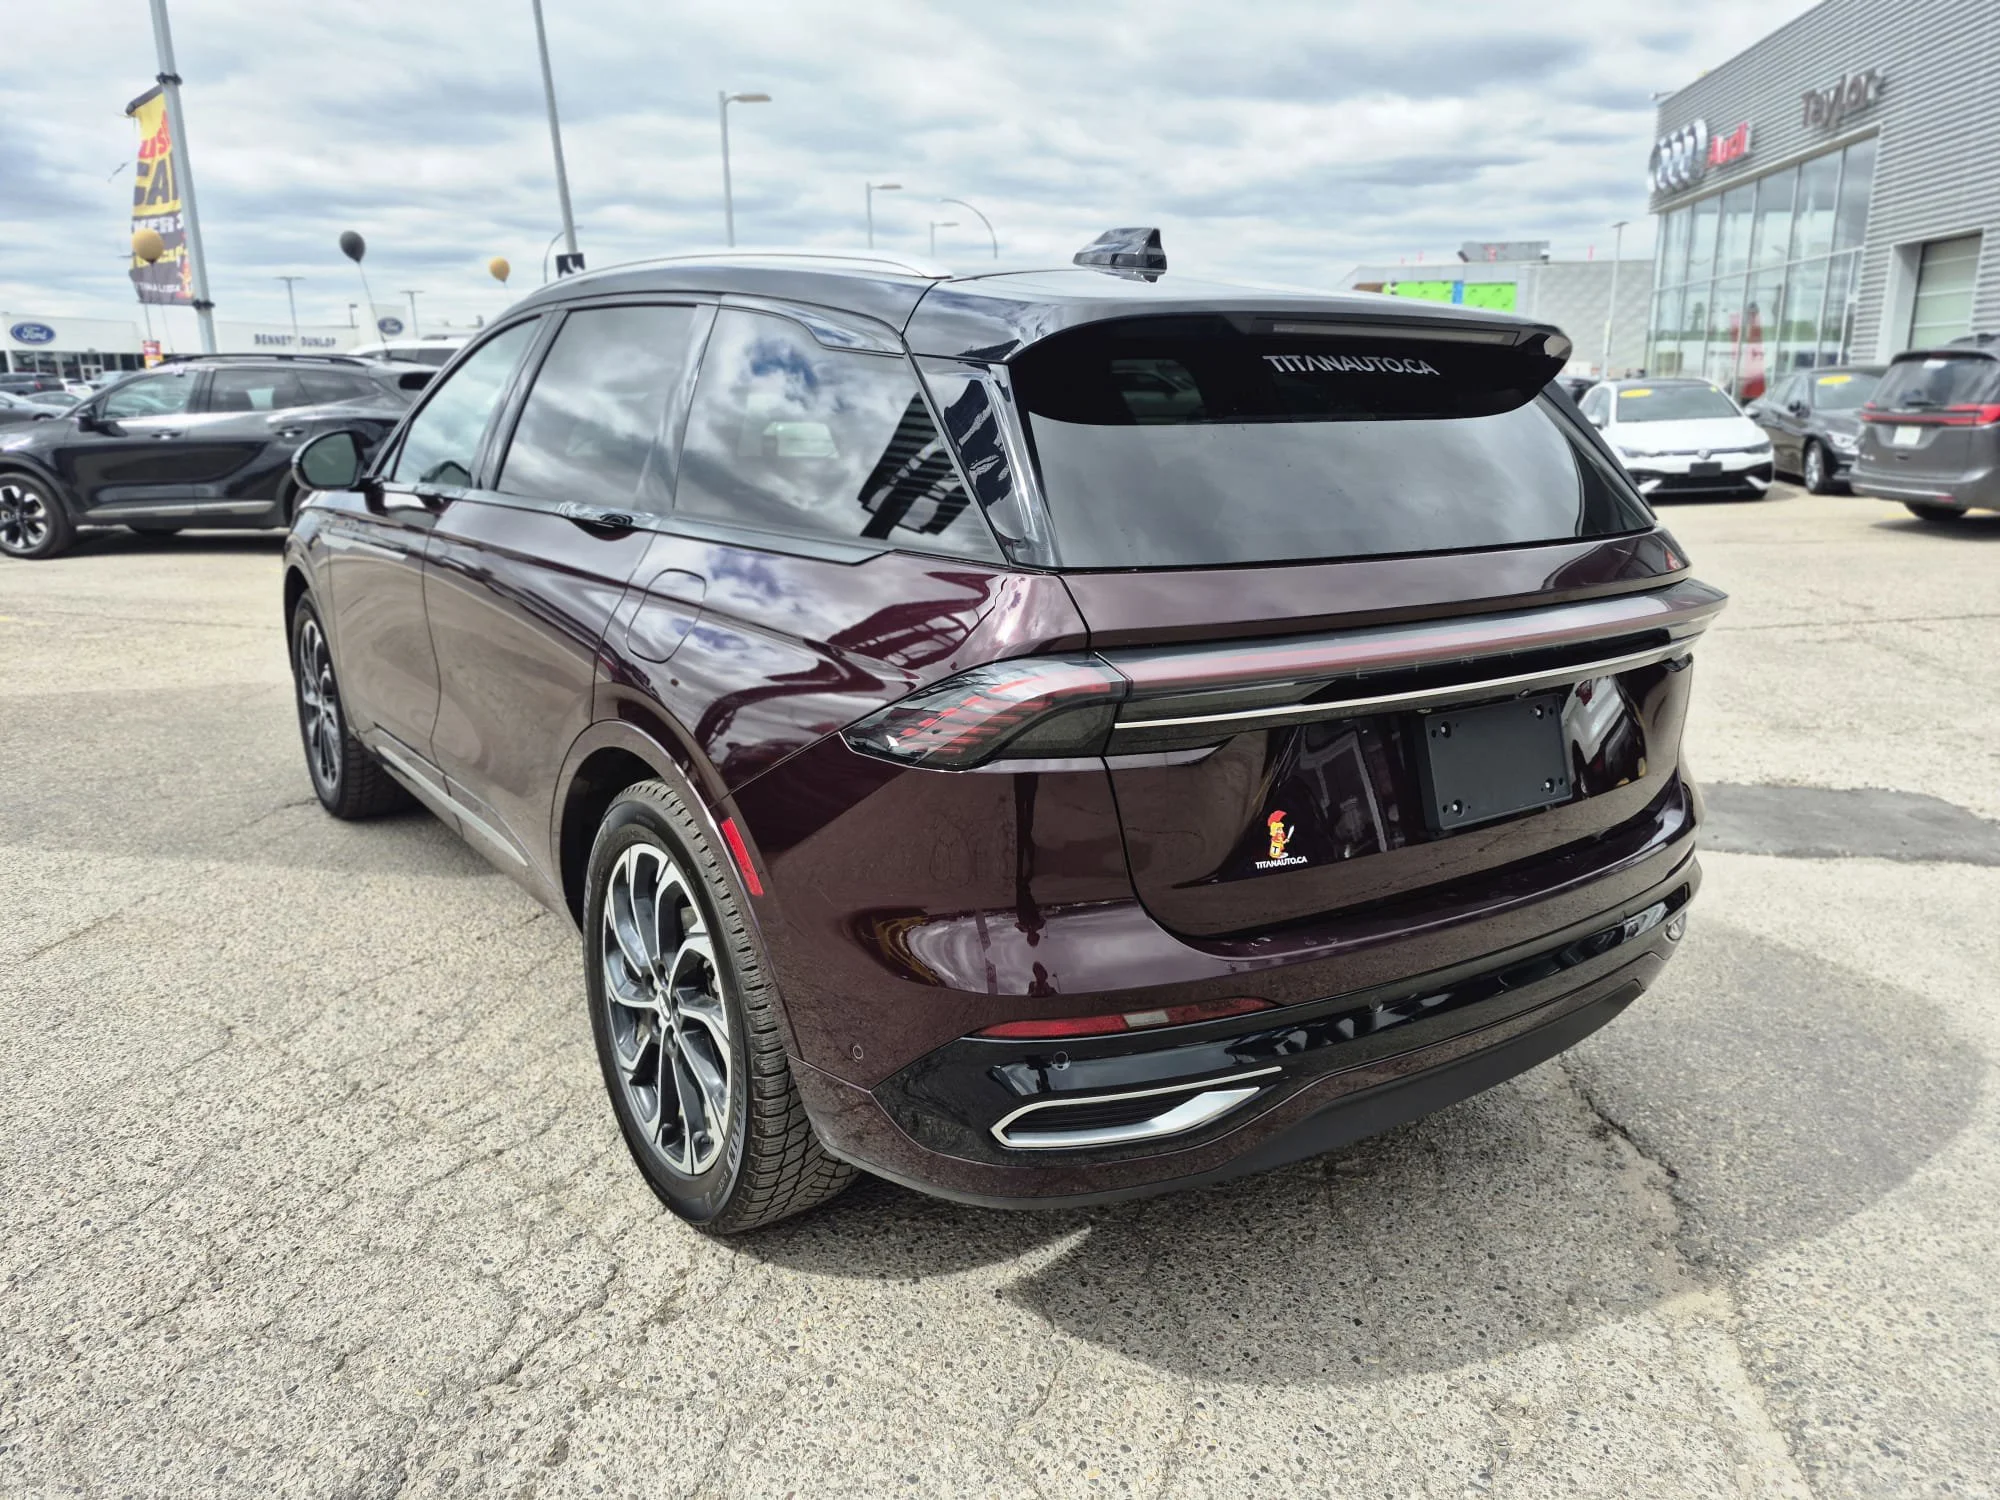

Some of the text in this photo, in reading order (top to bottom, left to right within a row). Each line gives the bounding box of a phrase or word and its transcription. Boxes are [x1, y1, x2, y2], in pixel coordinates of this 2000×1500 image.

[1801, 67, 1882, 129] Taylor
[254, 333, 297, 347] BENNET
[1262, 355, 1441, 376] TITANAUTO.CA
[1255, 855, 1308, 870] TITANAUTO.CA
